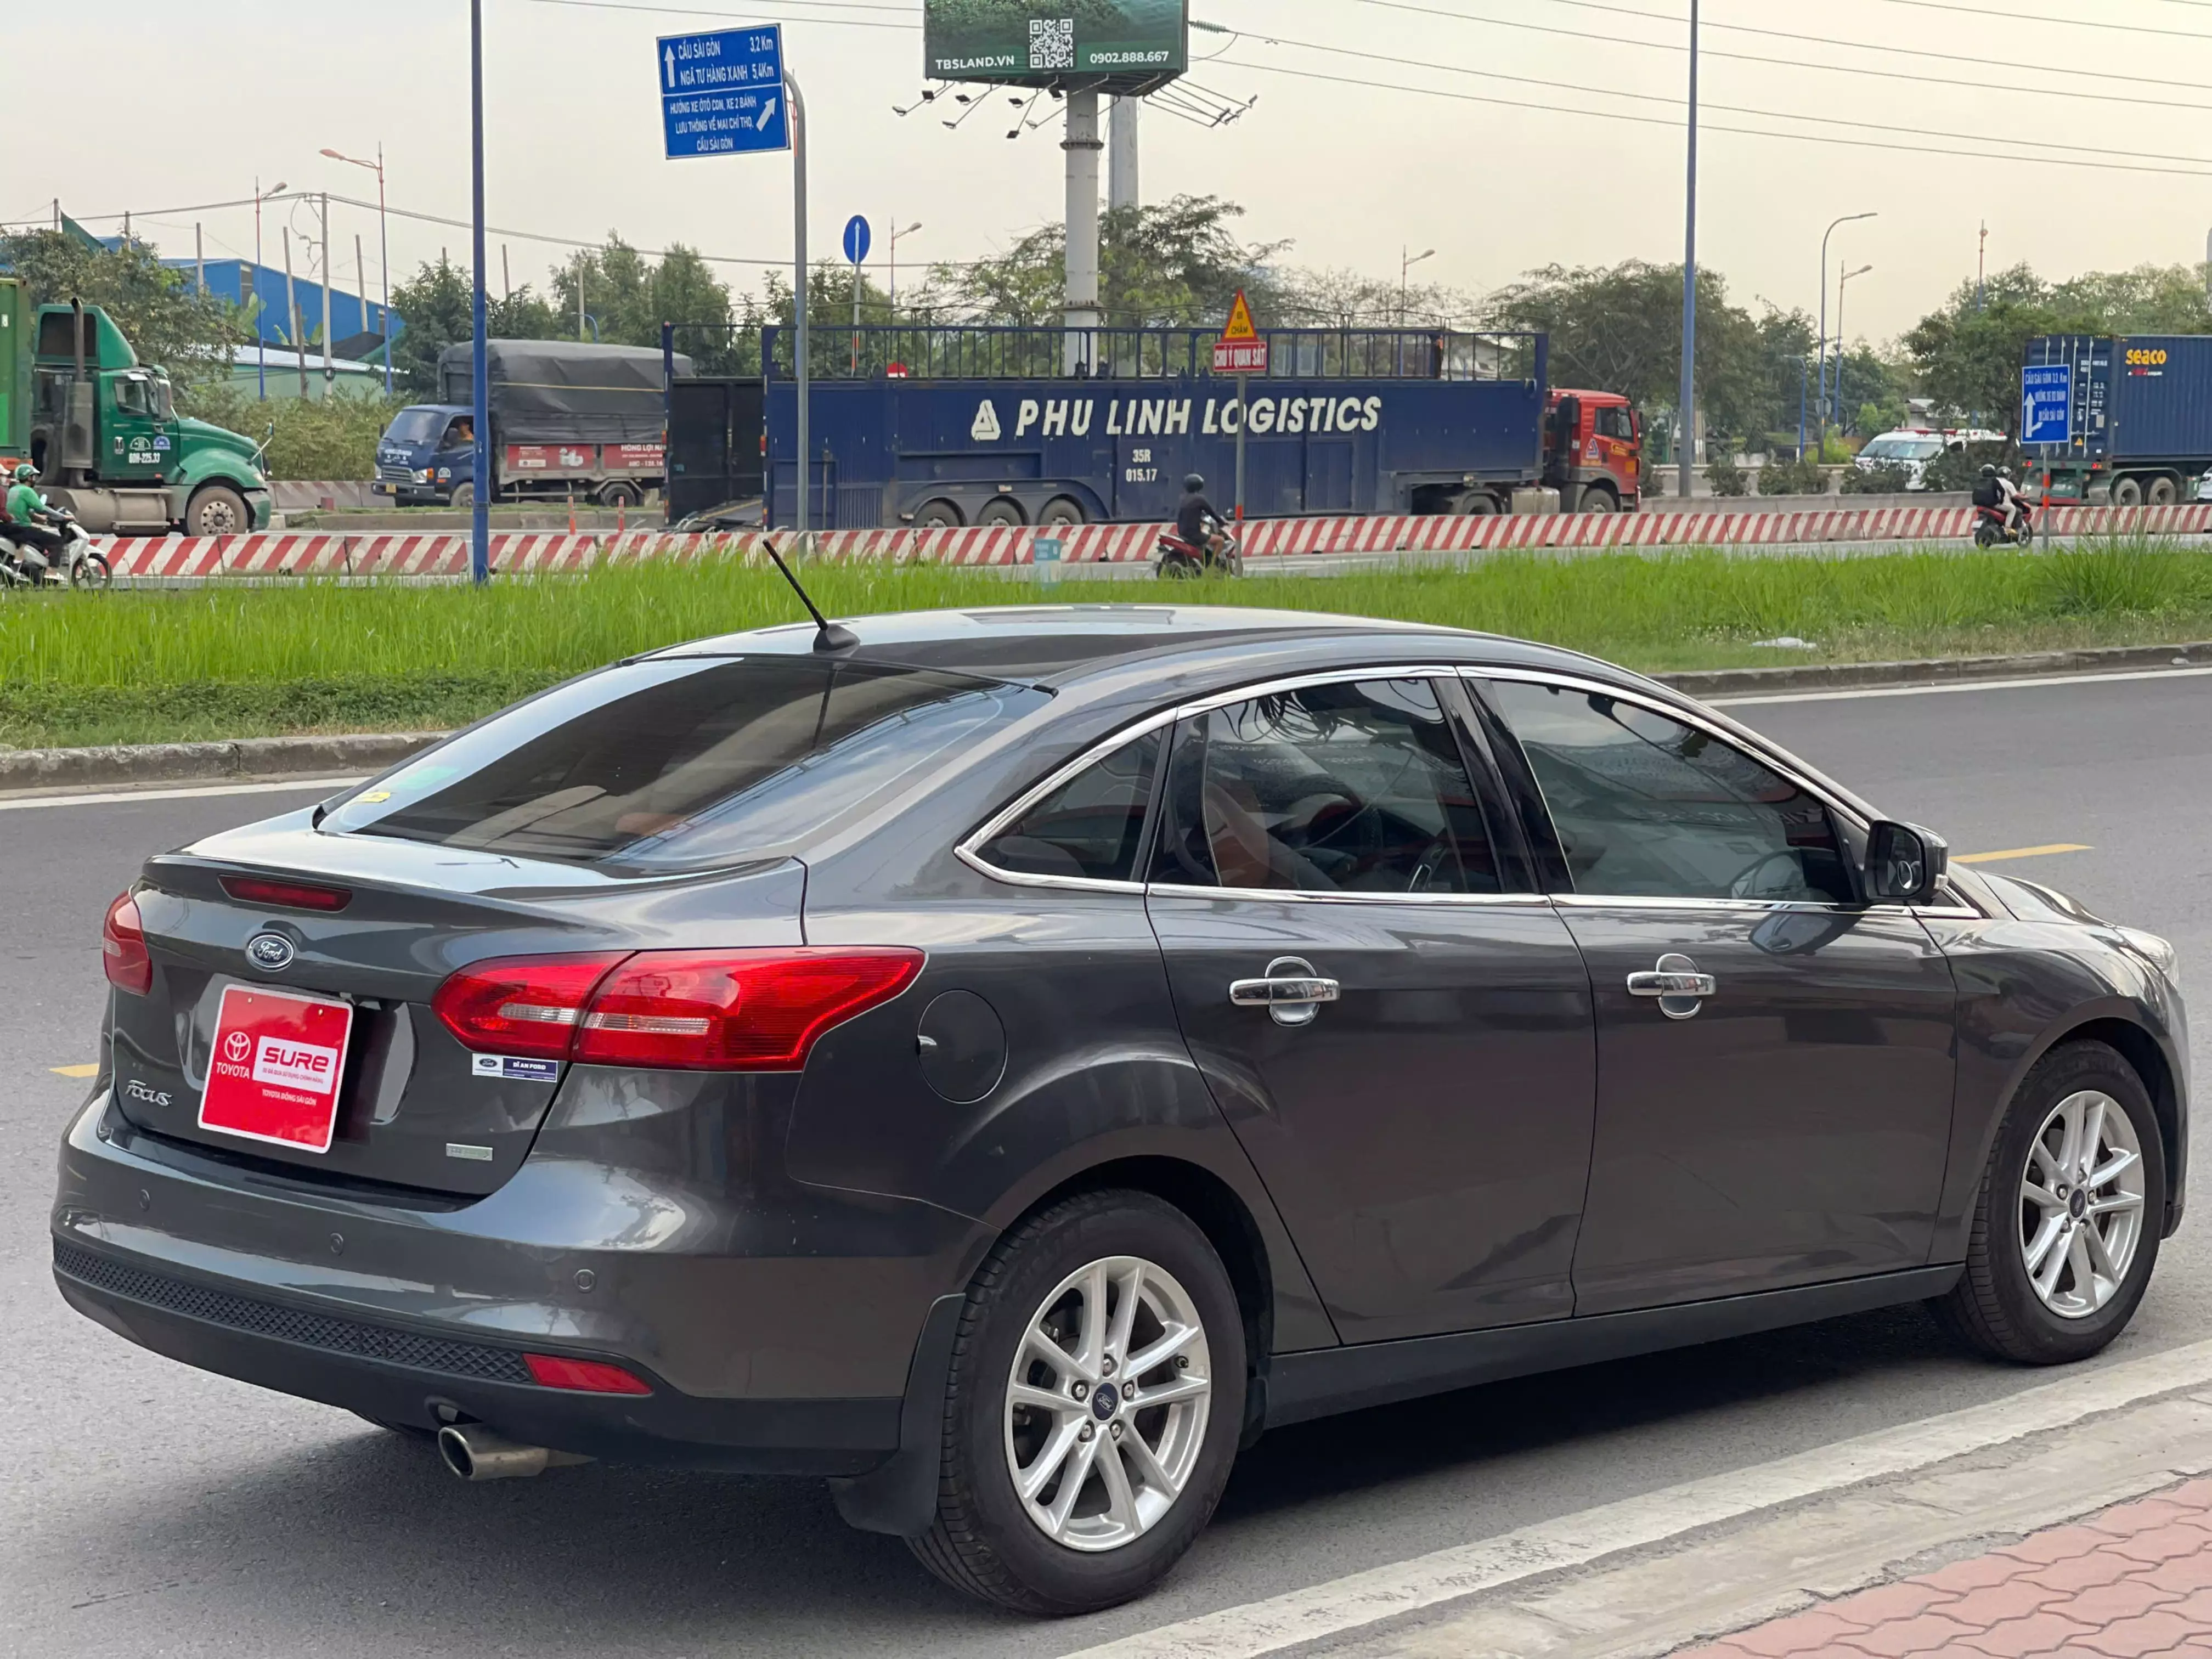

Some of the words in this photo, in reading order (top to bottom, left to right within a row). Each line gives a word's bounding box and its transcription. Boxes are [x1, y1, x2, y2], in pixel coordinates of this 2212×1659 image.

[678, 39, 692, 60] CẦU
[693, 38, 705, 59] SÀI
[706, 37, 721, 57] GÒN
[749, 36, 760, 53] 3,2
[761, 35, 773, 50] Km
[935, 55, 1014, 70] TBSLAND.VN
[1090, 51, 1169, 64] 0902.888.667
[680, 67, 696, 86] NGÃ
[707, 63, 726, 83] HÀNG
[727, 65, 748, 81] XANH
[691, 100, 699, 112] XE
[726, 98, 734, 110] XE
[735, 97, 738, 109] 2
[740, 93, 757, 108] BÁNH
[688, 118, 707, 132] THÔNG
[717, 119, 728, 131] MAI
[729, 113, 739, 129] CHÍ
[709, 136, 720, 150] SÀI
[720, 134, 733, 149] GÒN
[1252, 344, 1265, 366] SÁT
[2125, 349, 2166, 365] seaco
[1015, 399, 1093, 436] PHU
[1106, 399, 1192, 435] LINH
[1201, 396, 1381, 433] LOGISTICS
[1132, 448, 1151, 462] 35R
[1126, 468, 1158, 482] 015.17
[216, 1062, 250, 1079] TOYOTA
[262, 1088, 280, 1099] TOYOTA
